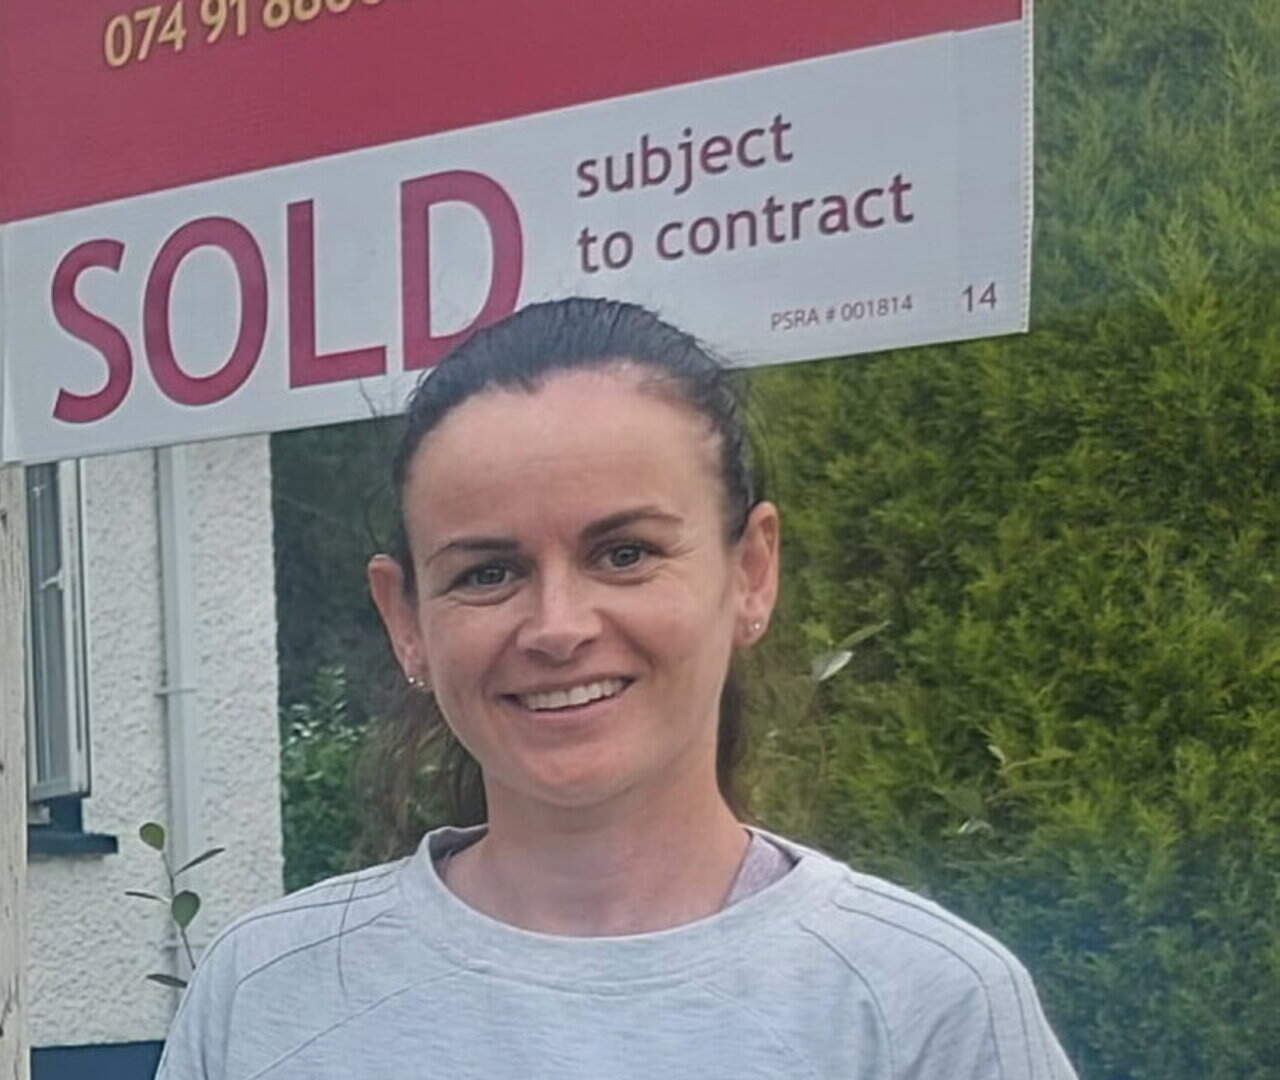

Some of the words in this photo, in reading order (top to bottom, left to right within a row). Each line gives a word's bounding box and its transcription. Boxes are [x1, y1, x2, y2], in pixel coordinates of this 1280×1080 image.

[104, 1, 188, 67] 074
[200, 0, 247, 44] 91
[576, 114, 794, 198] subject
[577, 226, 635, 273] to
[656, 173, 915, 261] contract
[51, 169, 524, 424] SOLD
[770, 311, 820, 332] PSRA
[825, 306, 836, 320] #
[841, 294, 913, 323] 001814
[962, 281, 998, 313] 14
